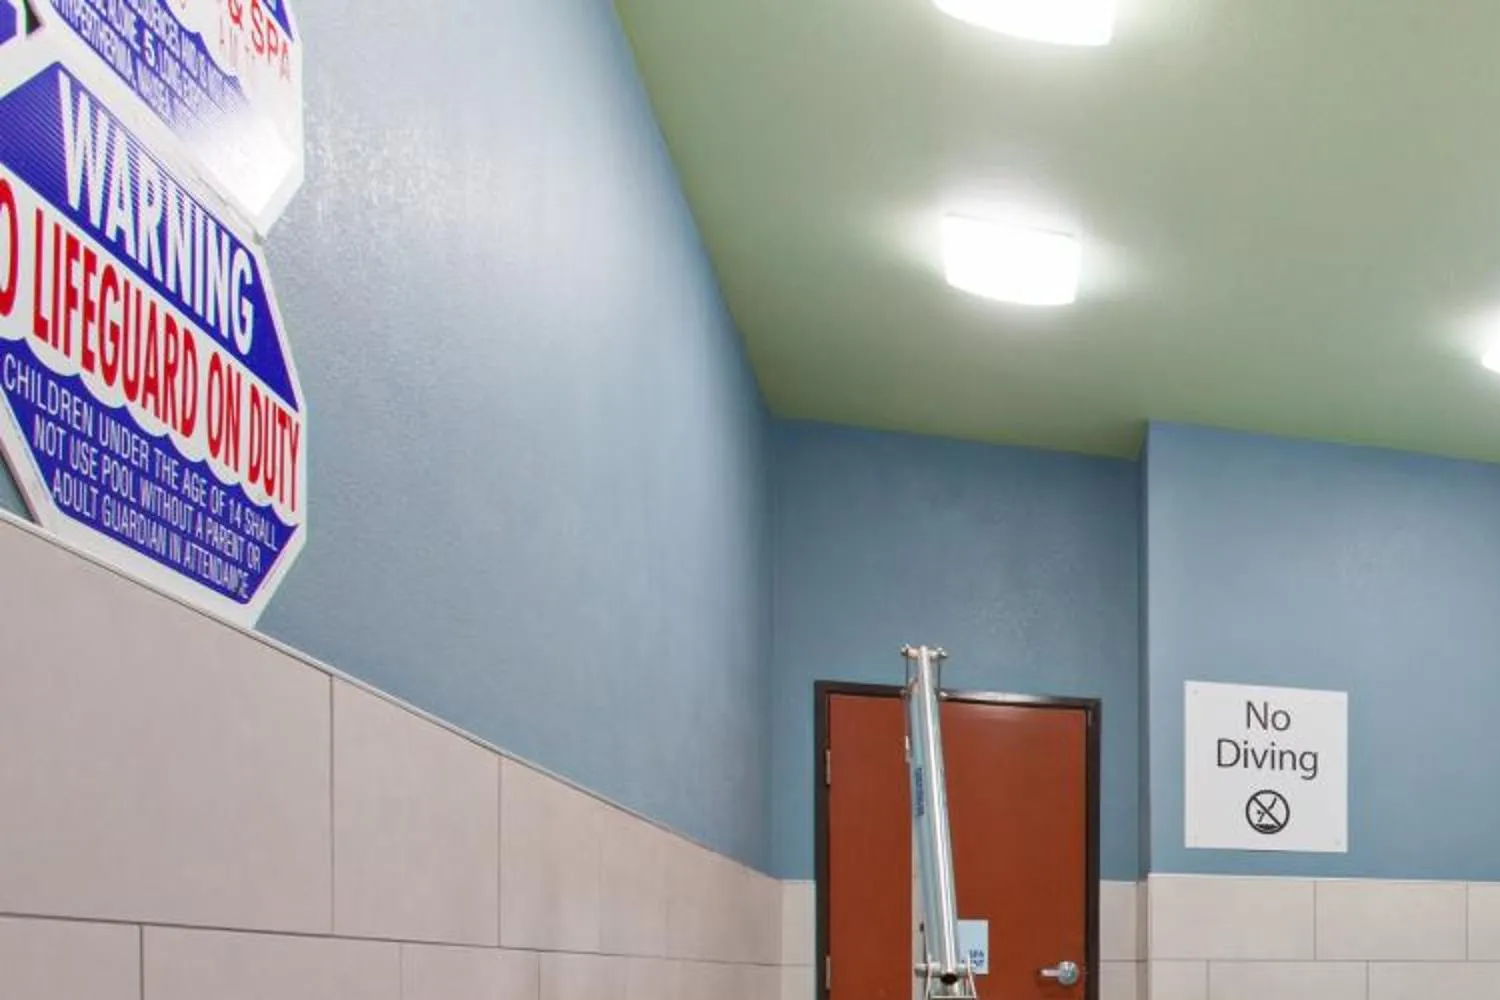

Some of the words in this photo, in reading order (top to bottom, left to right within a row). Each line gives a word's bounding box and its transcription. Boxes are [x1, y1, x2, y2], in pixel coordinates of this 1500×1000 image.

[57, 69, 253, 355] WARNING
[0, 178, 19, 316] O
[33, 207, 199, 438] LIFEGUARD
[206, 351, 241, 472] ON
[248, 383, 299, 512] DUTY
[3, 353, 94, 437] CHILDREN
[98, 411, 150, 472] UNDER
[153, 447, 180, 490] THE
[181, 467, 208, 507] AGE
[210, 485, 228, 516] OF
[229, 499, 243, 529] 14
[244, 507, 278, 551] SHALL
[33, 414, 66, 461] NOT
[69, 435, 99, 482] USE
[101, 454, 137, 503] POOL
[138, 476, 195, 533] WITHOUT
[195, 511, 204, 541] A
[205, 517, 245, 565] PARENT
[246, 540, 261, 573] OR
[52, 468, 98, 520] ADULT
[101, 494, 167, 556] GUARDIAN
[169, 530, 182, 564] IN
[1216, 737, 1320, 781] Diving
[1246, 700, 1292, 732] No
